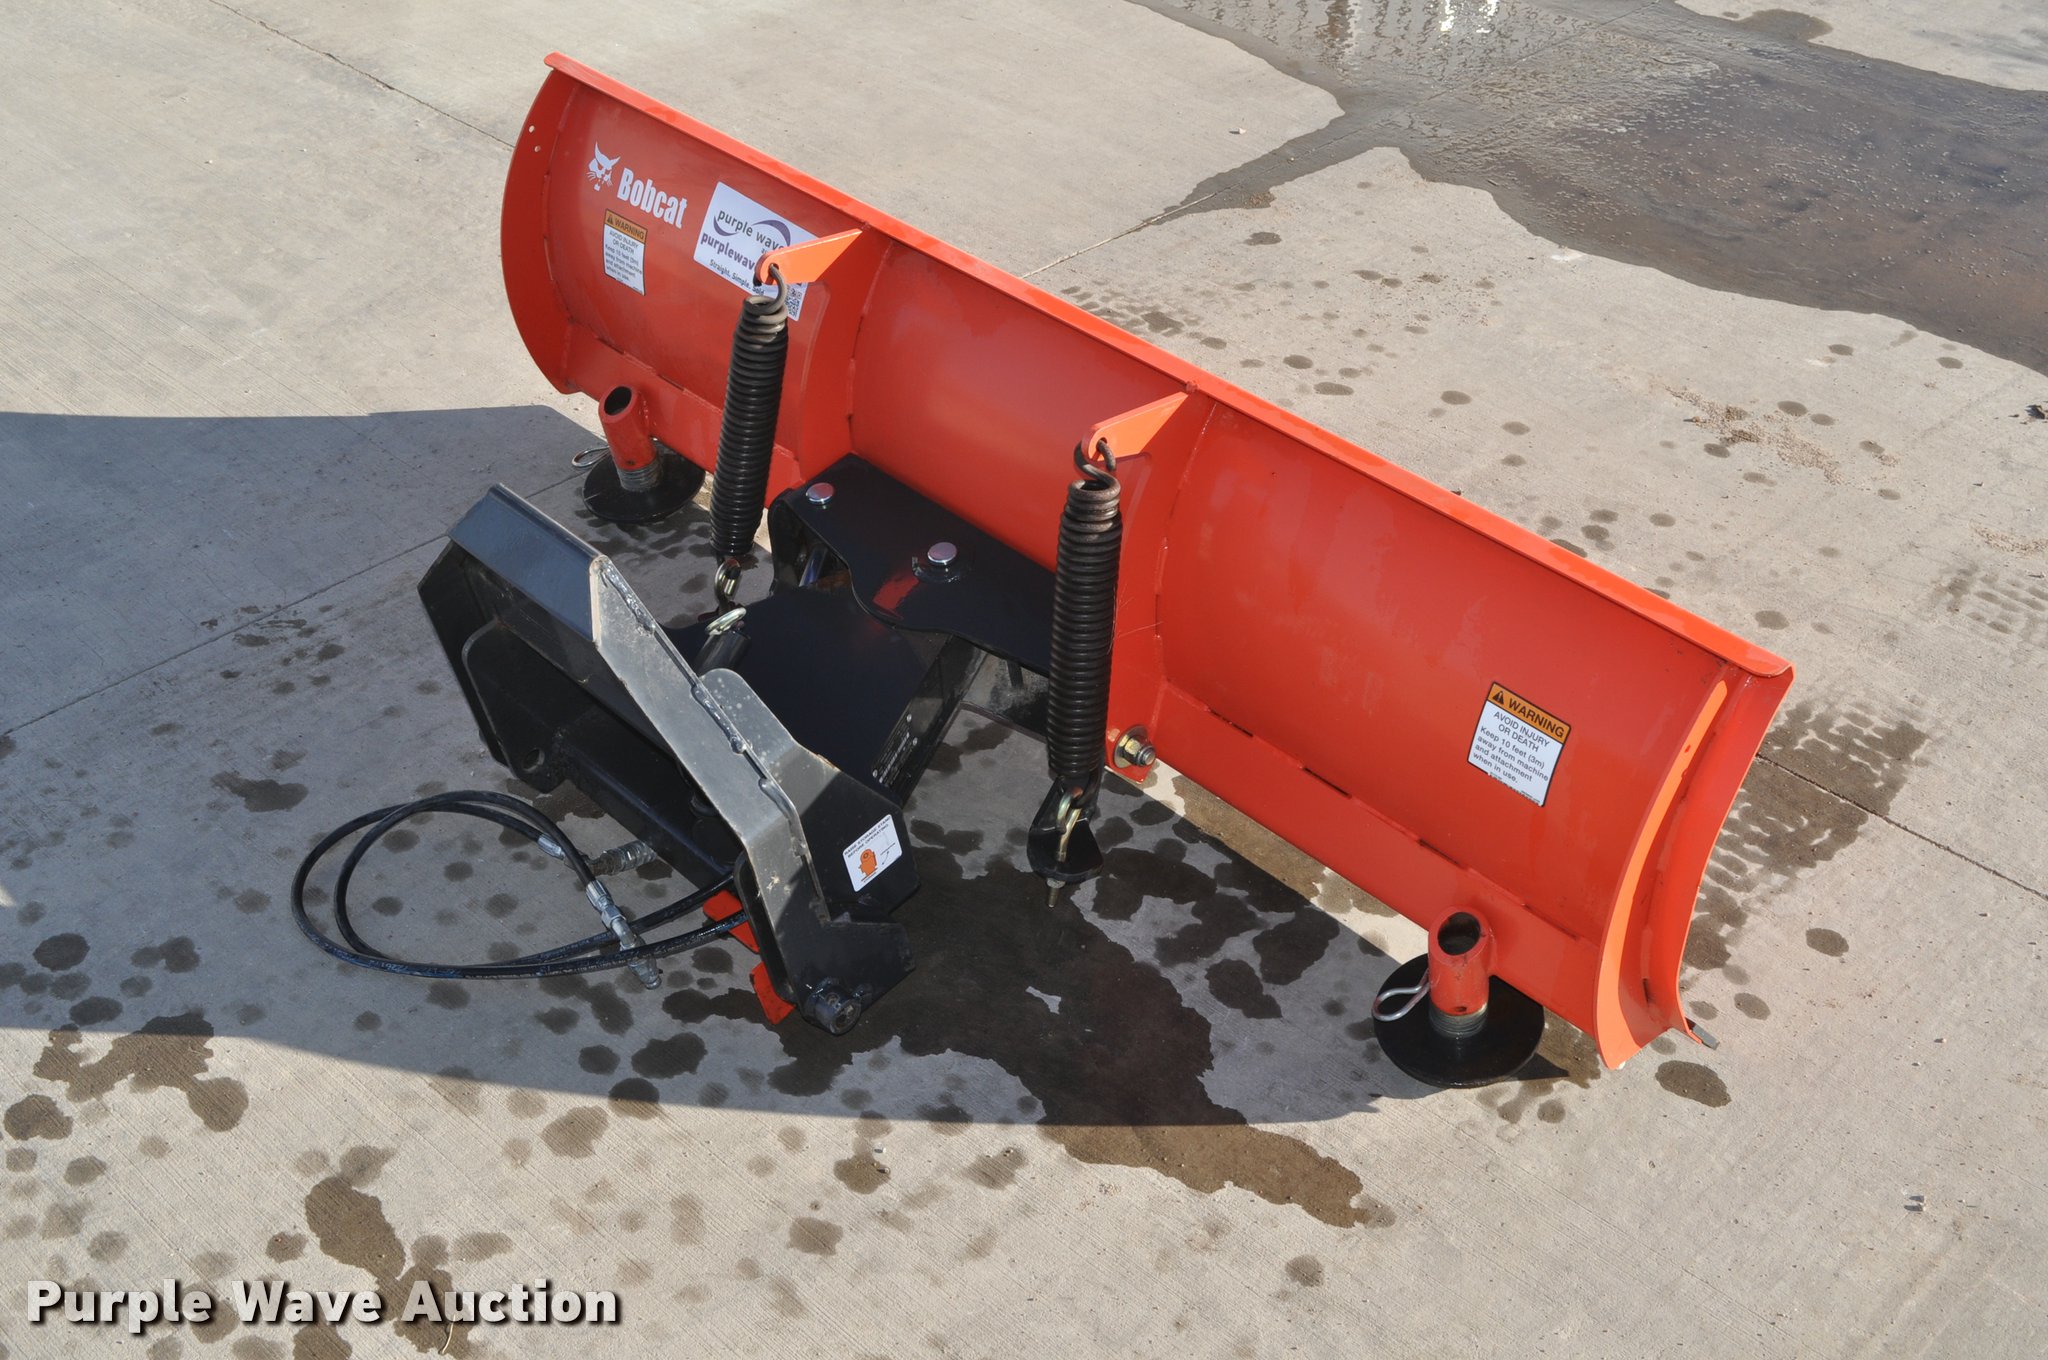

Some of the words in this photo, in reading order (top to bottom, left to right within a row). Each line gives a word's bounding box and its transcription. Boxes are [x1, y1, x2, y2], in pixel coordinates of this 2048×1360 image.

[617, 167, 688, 229] Bobcat
[615, 218, 644, 239] WARNING
[718, 209, 753, 236] purple
[701, 232, 755, 271] purplewav
[1494, 711, 1519, 730] AVOID
[1519, 725, 1550, 747] INJURY
[1509, 698, 1564, 738] WARNING
[1481, 726, 1499, 743] Keep
[1502, 739, 1511, 748] 10
[1512, 744, 1527, 758] feet
[1527, 754, 1545, 770] (3m)
[1498, 723, 1511, 735] OR
[1511, 731, 1539, 752] DEATH
[1473, 752, 1492, 766] when
[1494, 763, 1501, 773] in
[1502, 770, 1518, 783] use.
[1475, 744, 1489, 756] and
[1491, 753, 1533, 782] attachment
[1477, 736, 1497, 751] away
[1498, 747, 1515, 762] from
[1517, 759, 1549, 781] machine
